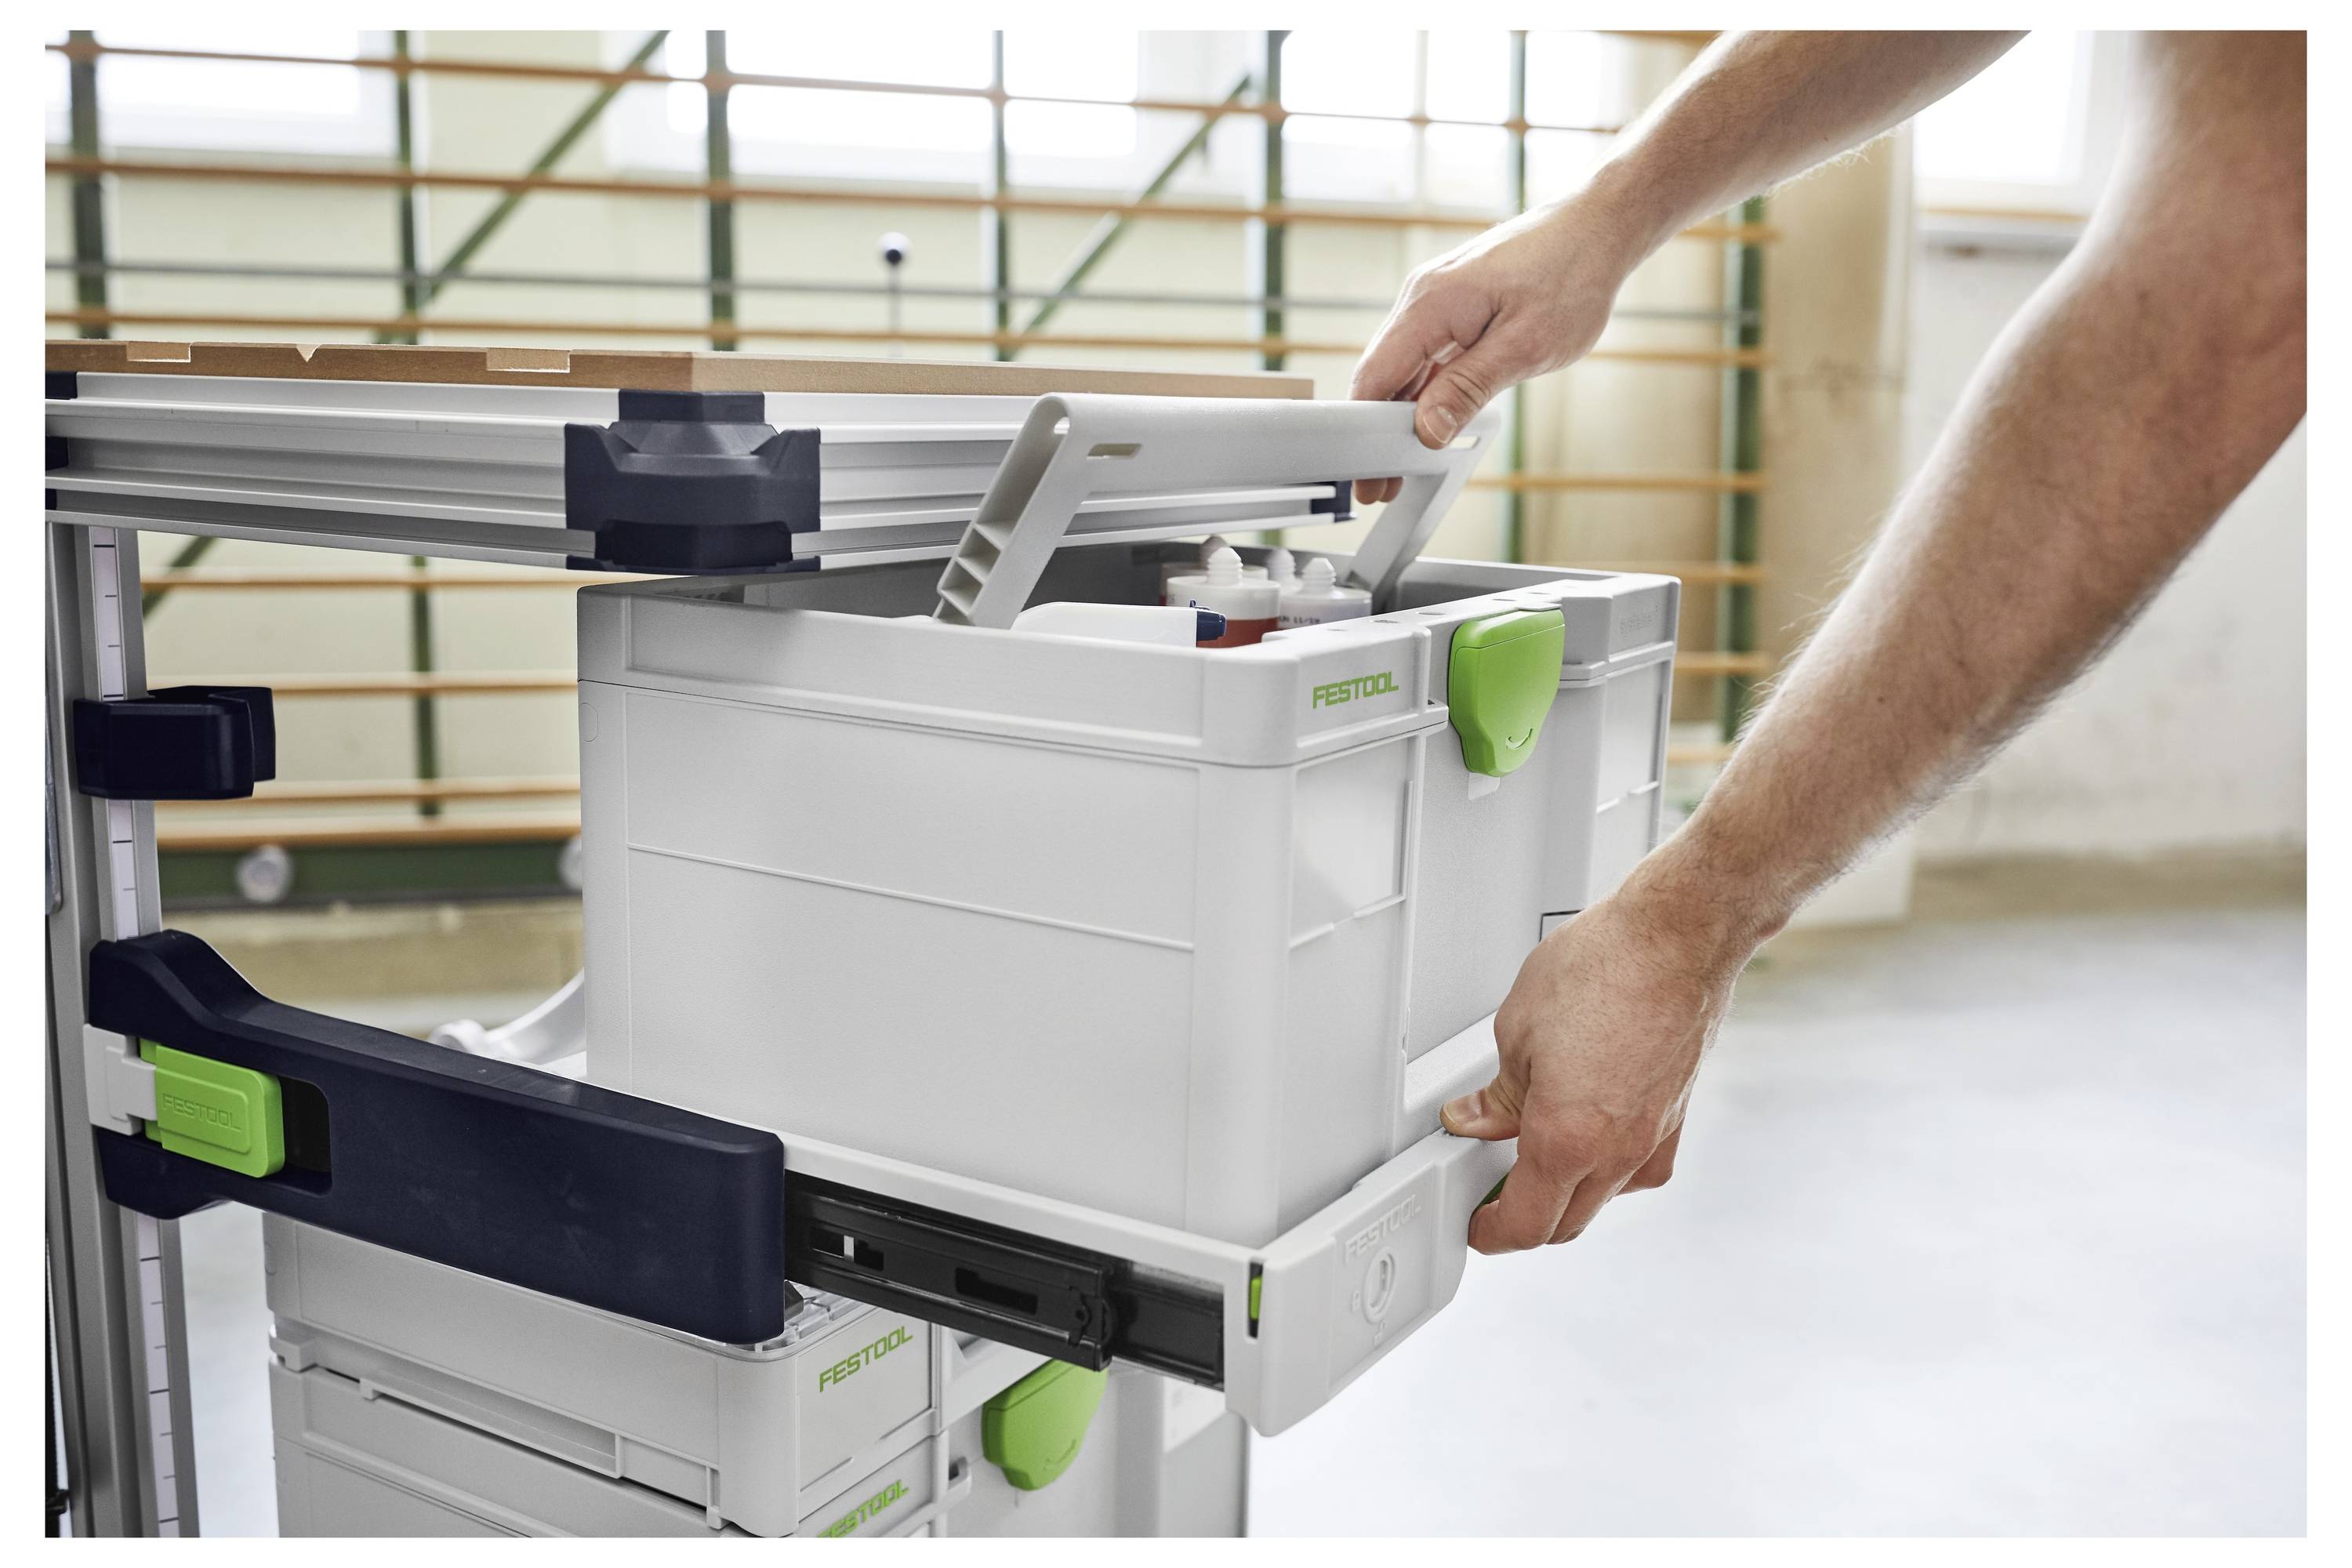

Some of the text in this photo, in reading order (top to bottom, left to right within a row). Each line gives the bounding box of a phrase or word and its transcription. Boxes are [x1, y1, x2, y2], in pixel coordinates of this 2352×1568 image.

[1312, 671, 1399, 709] FESTOOL
[162, 1093, 241, 1132] FESTOOL
[1343, 1194, 1421, 1266] FESTOOL
[819, 1326, 913, 1392] FESTOOL
